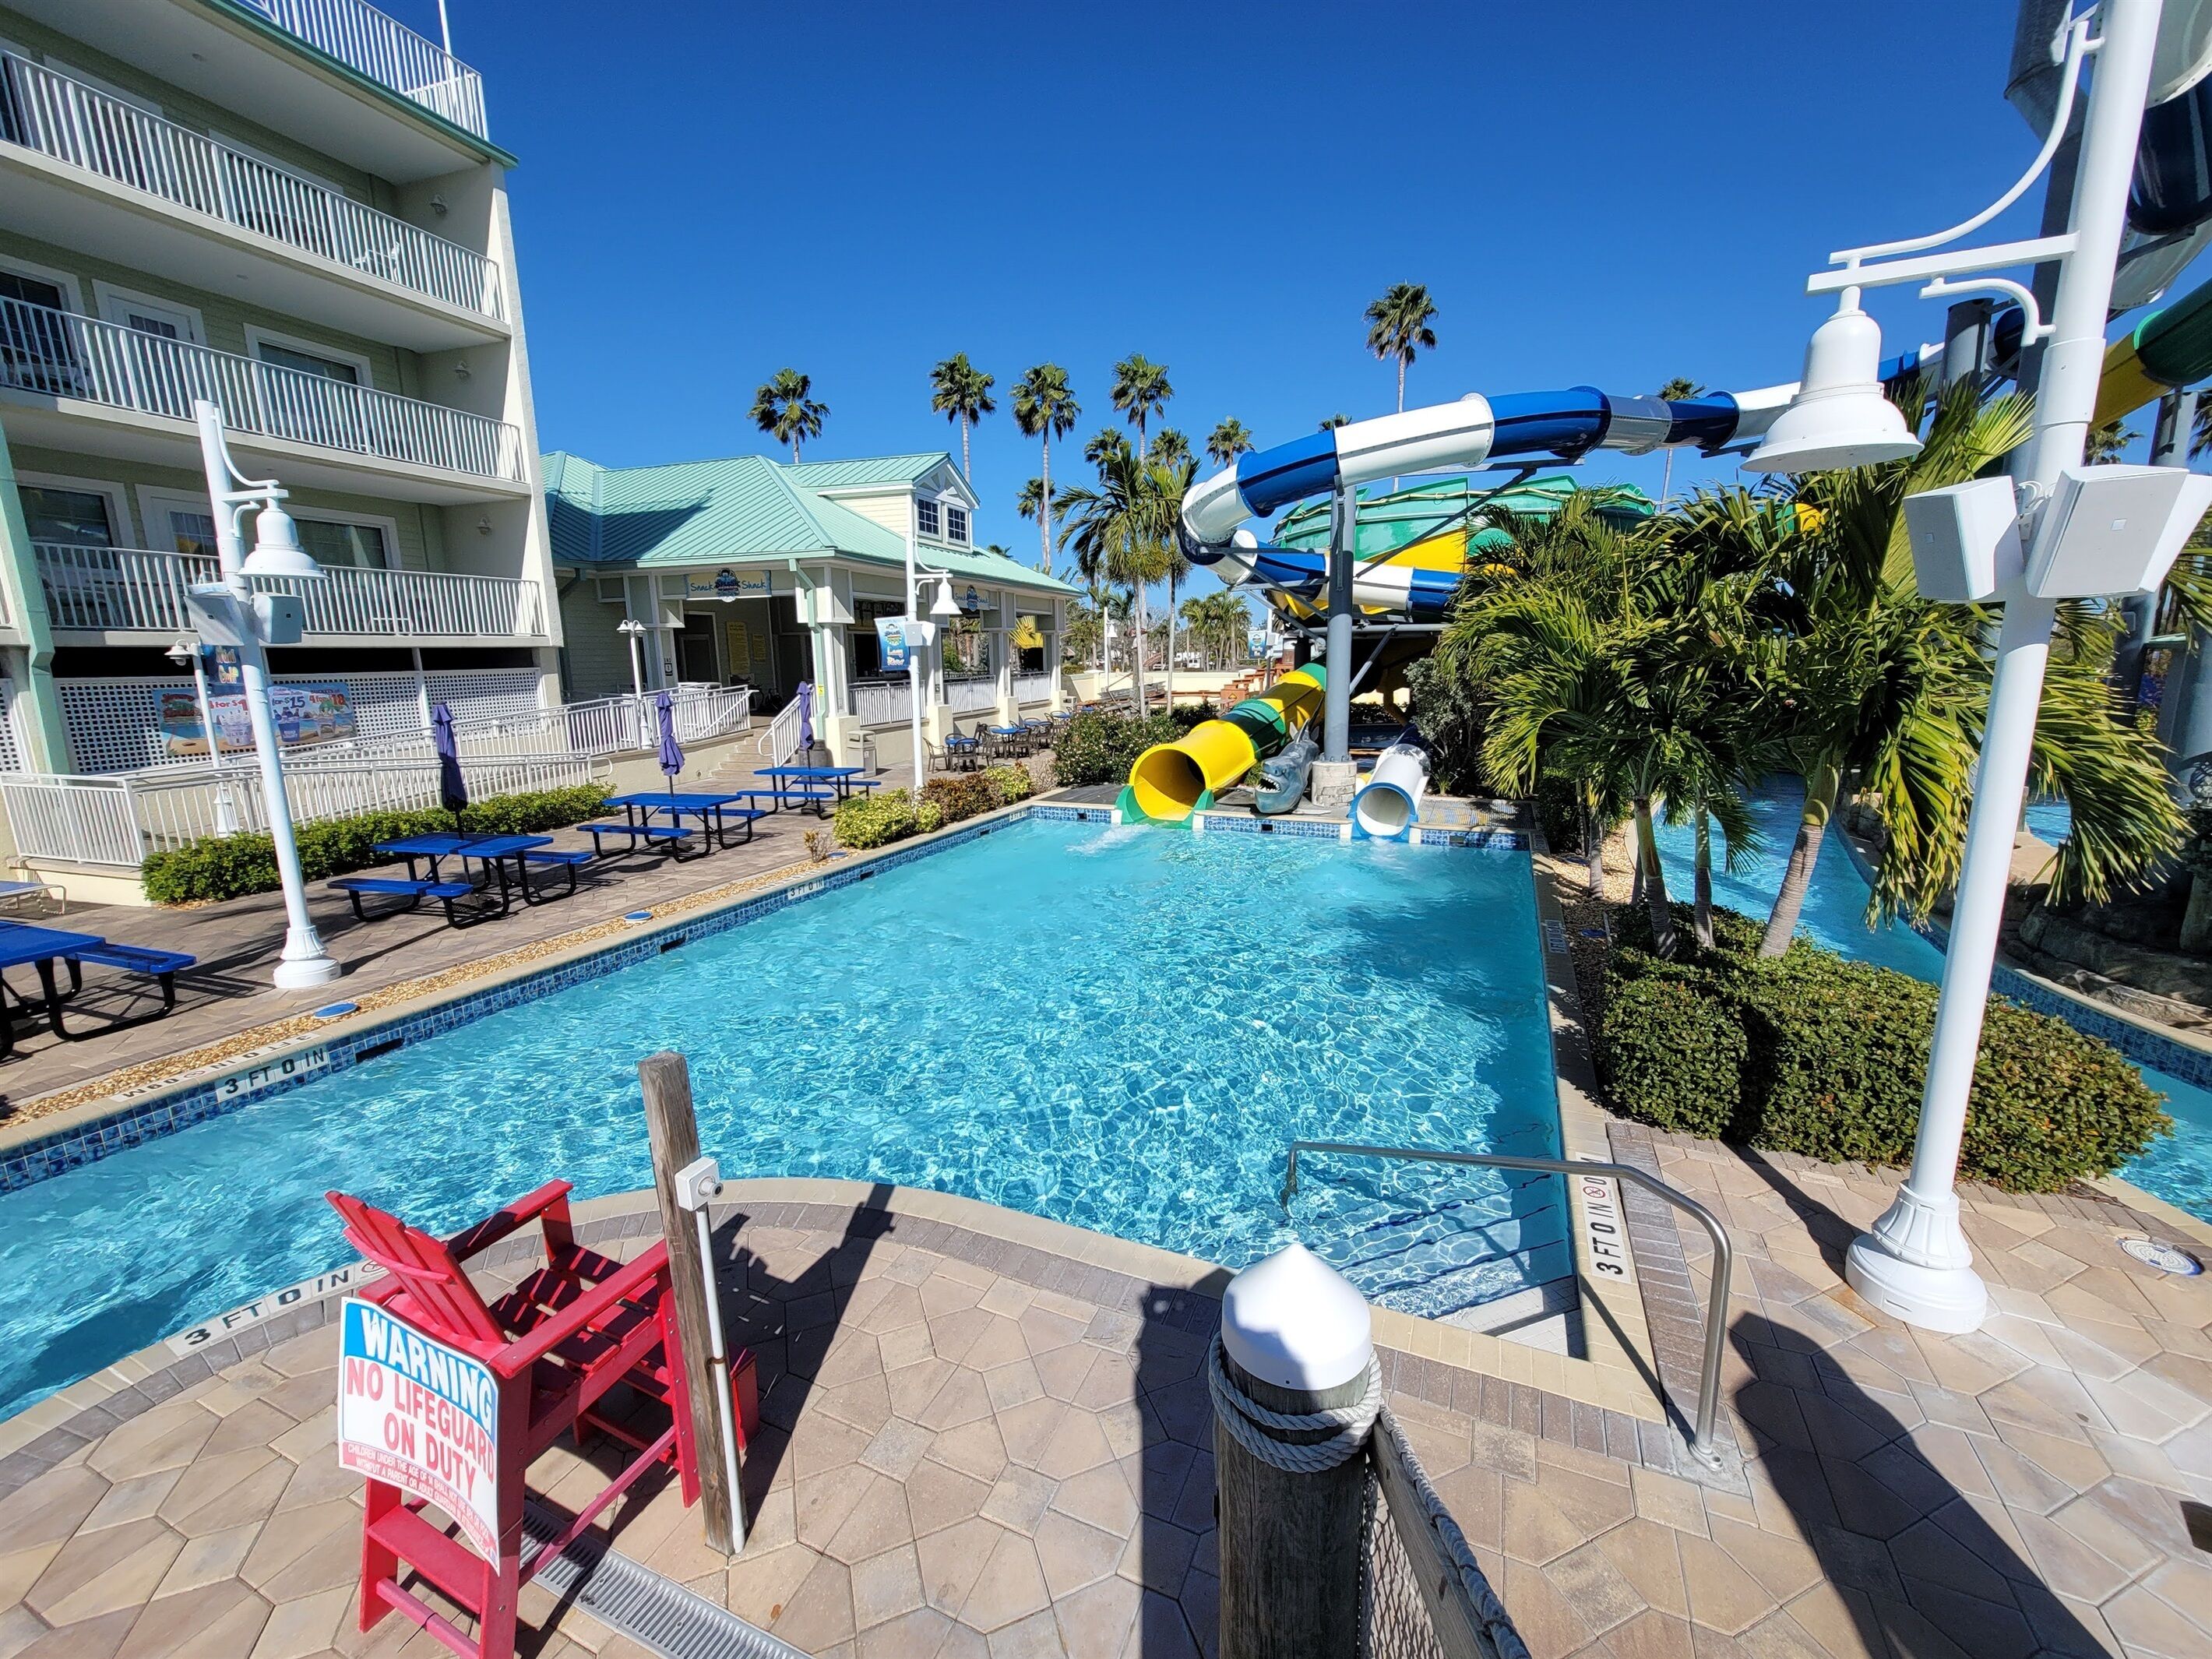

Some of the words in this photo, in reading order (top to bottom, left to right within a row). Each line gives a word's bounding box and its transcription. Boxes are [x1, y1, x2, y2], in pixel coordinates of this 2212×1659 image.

[690, 579, 714, 592] Snack
[741, 579, 766, 590] Shack
[887, 646, 903, 658] Lazy
[284, 696, 306, 709] $15
[791, 887, 796, 896] 3
[798, 884, 805, 894] FT
[268, 1041, 292, 1051] FT
[210, 1059, 237, 1069] IN
[224, 1078, 238, 1094] 3
[248, 1065, 271, 1087] FT
[305, 1048, 325, 1067] IN
[1587, 1201, 1615, 1219] IN
[1592, 1237, 1621, 1259] FT
[1596, 1262, 1624, 1276] 3
[184, 1328, 212, 1346] 3
[223, 1302, 263, 1329] FT
[318, 1270, 349, 1293] IN
[361, 1308, 493, 1436] WARNING
[347, 1358, 383, 1401] NO
[394, 1372, 495, 1485] LIFEGUARD
[347, 1443, 376, 1460] CHILDREN
[377, 1452, 396, 1467] UNDER
[396, 1459, 407, 1473] THE
[408, 1465, 419, 1478] AGE
[421, 1471, 428, 1481] OF
[383, 1412, 416, 1460] ON
[425, 1432, 477, 1503] DUTY
[387, 1468, 408, 1485] PARENT
[409, 1477, 417, 1489] OR
